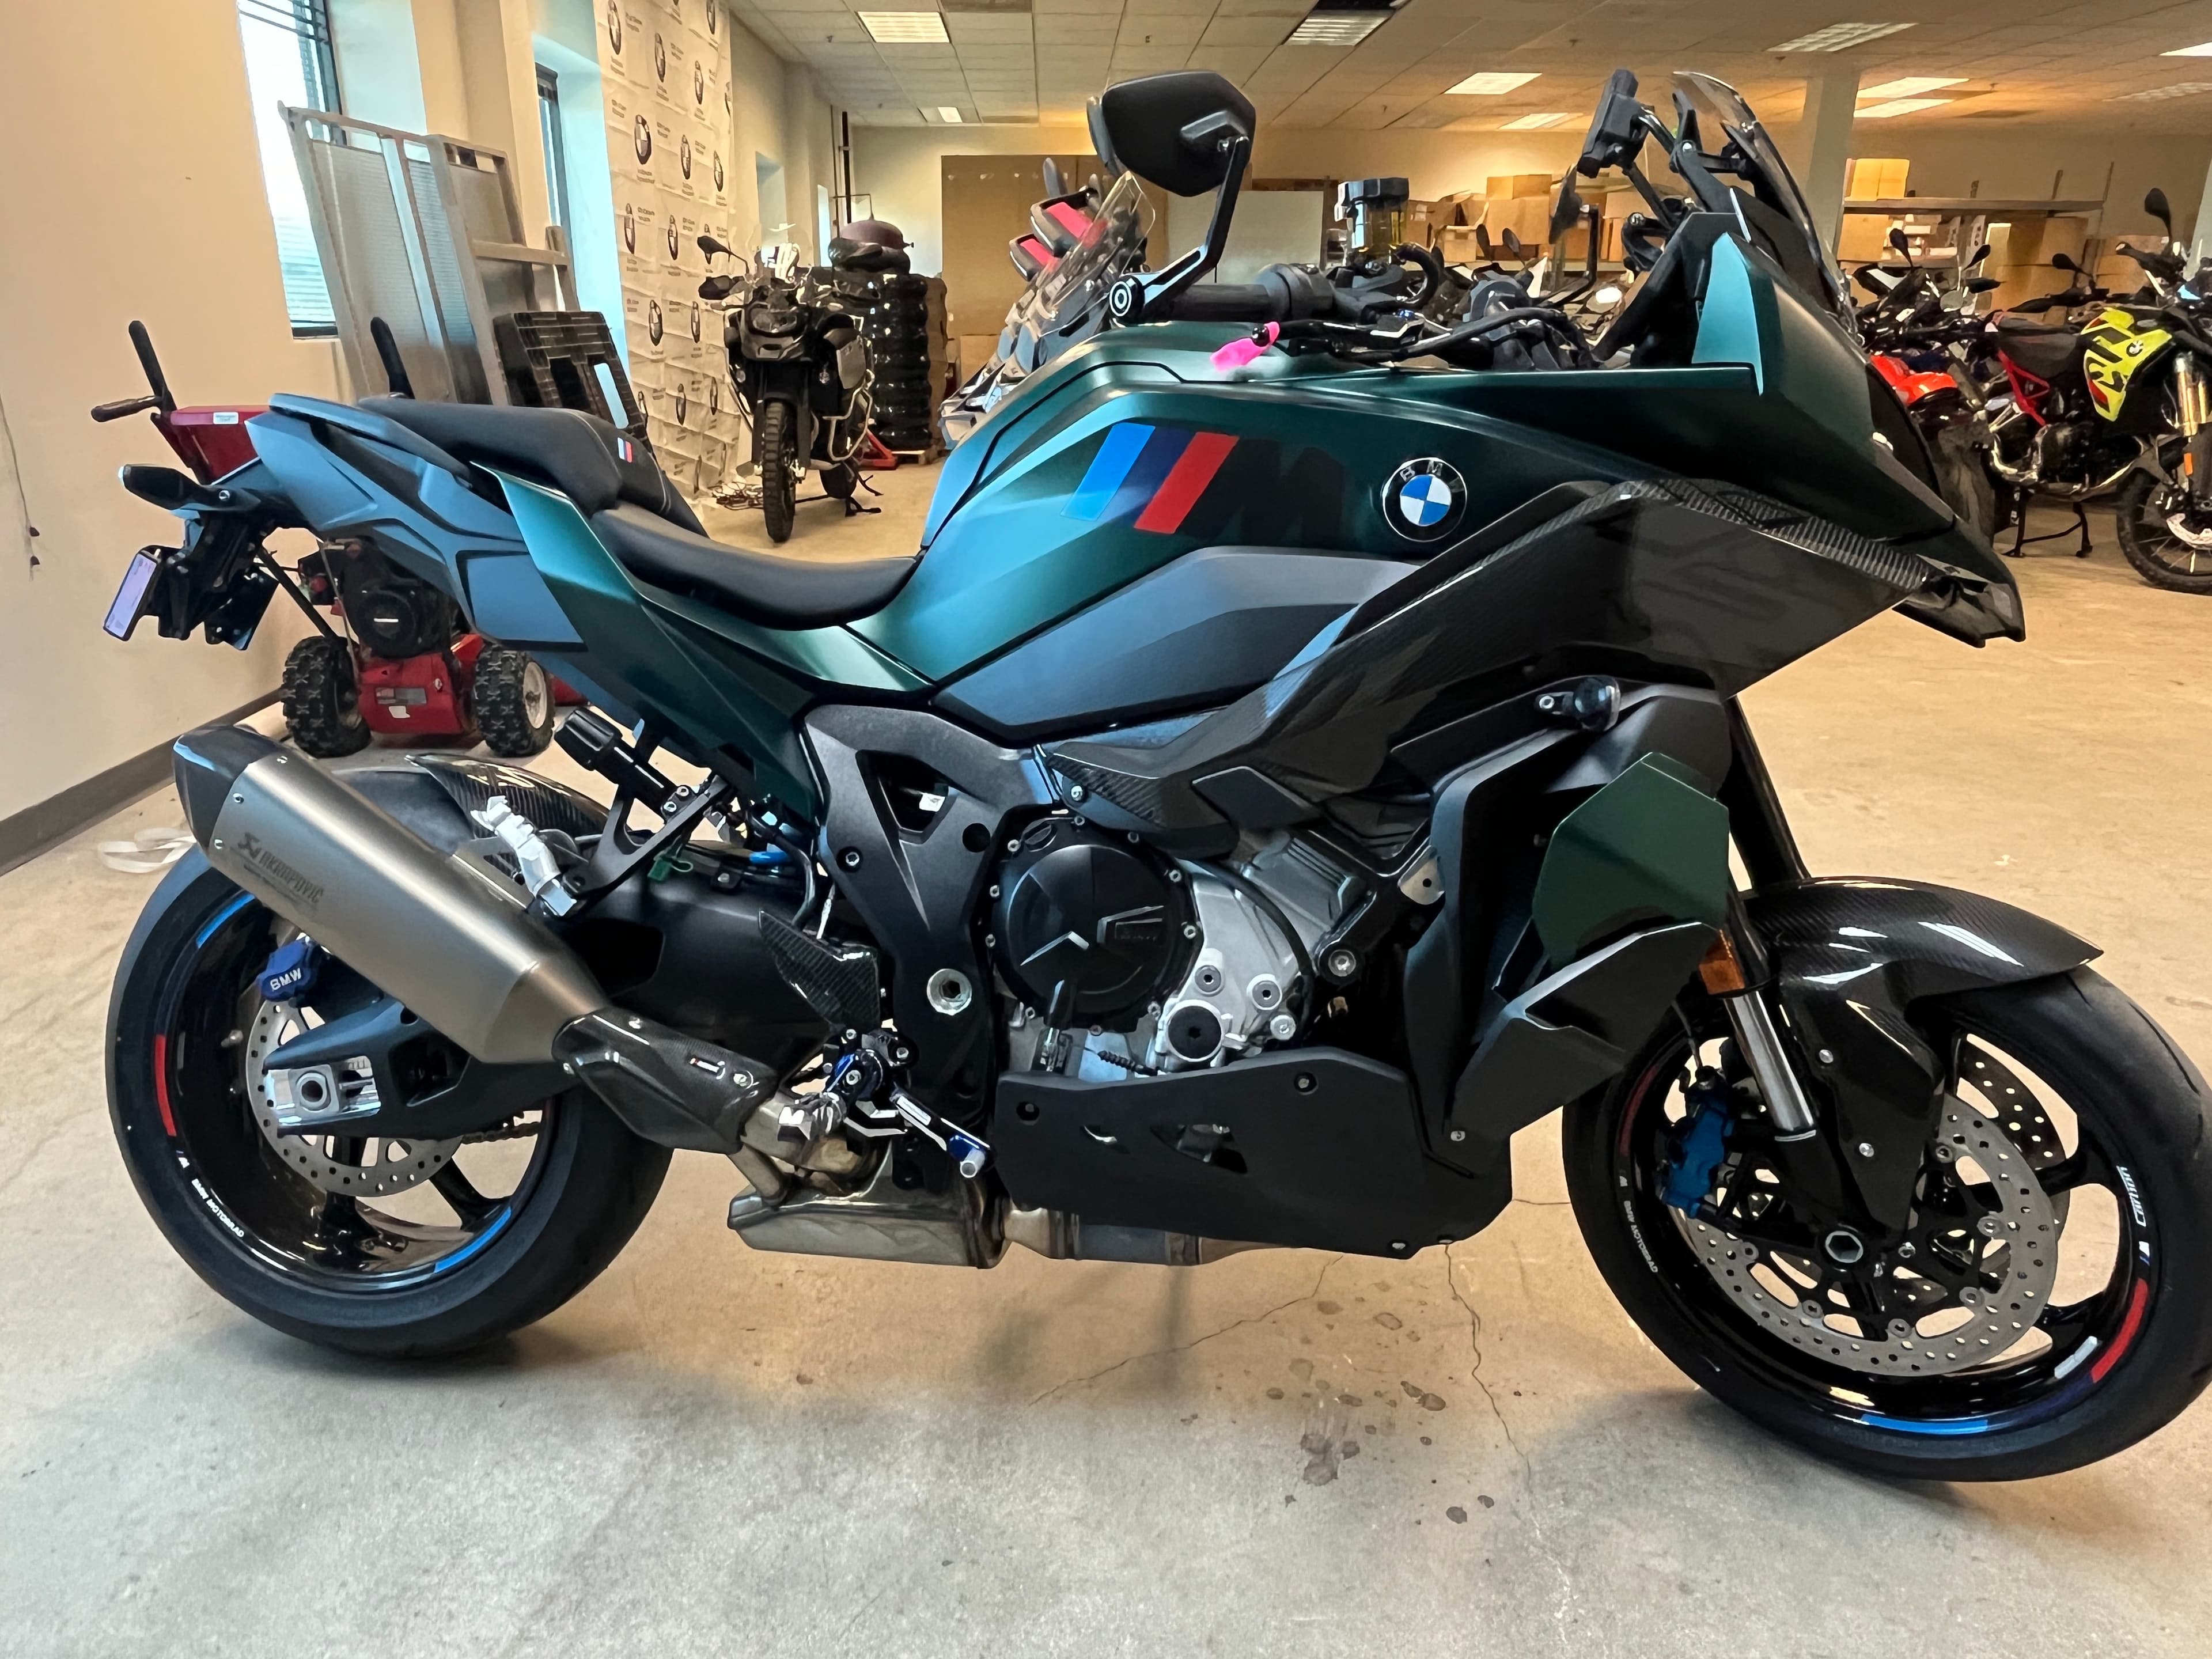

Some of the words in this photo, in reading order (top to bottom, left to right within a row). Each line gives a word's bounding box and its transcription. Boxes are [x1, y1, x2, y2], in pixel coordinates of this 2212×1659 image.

[270, 968, 301, 991] BMW
[206, 1199, 244, 1237] MOTORRAD
[1631, 1225, 1658, 1272] MOTORRAD
